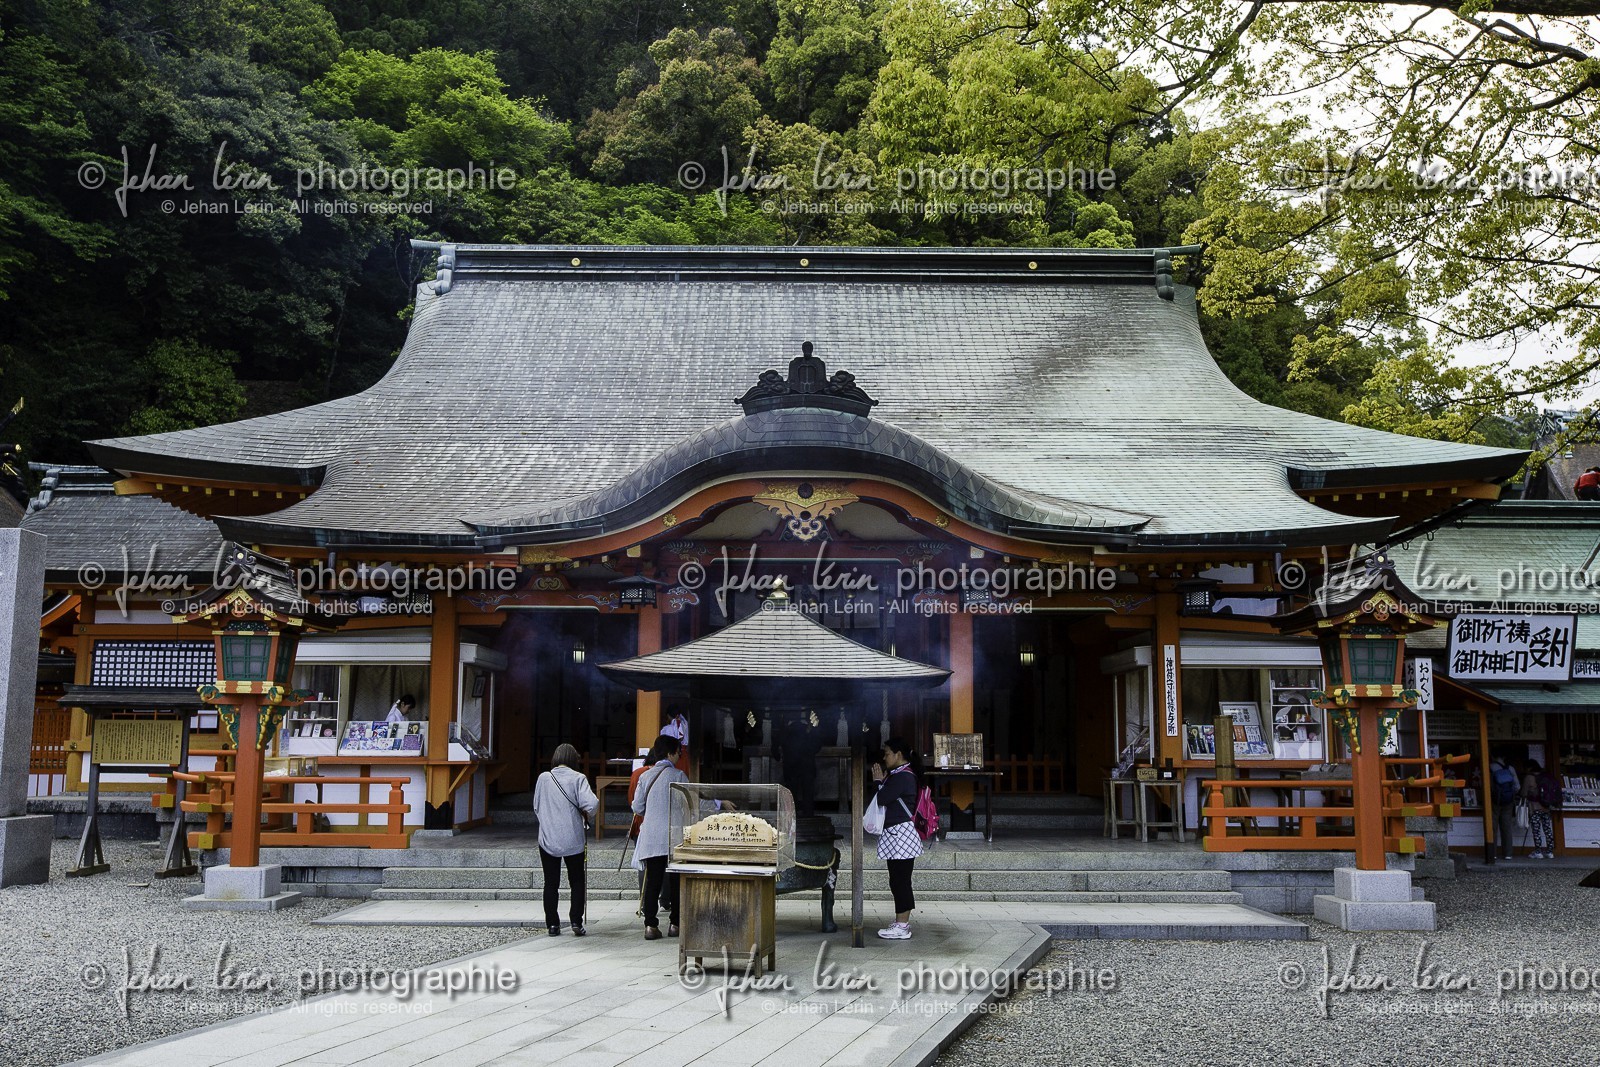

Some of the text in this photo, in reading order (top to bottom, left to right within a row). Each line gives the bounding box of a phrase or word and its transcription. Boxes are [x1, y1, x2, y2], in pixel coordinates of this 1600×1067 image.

[1456, 618, 1530, 643] 御祈祷
[1529, 626, 1569, 667] 受付
[1452, 650, 1528, 673] 御神印
[1407, 663, 1415, 688] おみ
[1419, 662, 1430, 705] おみくじ
